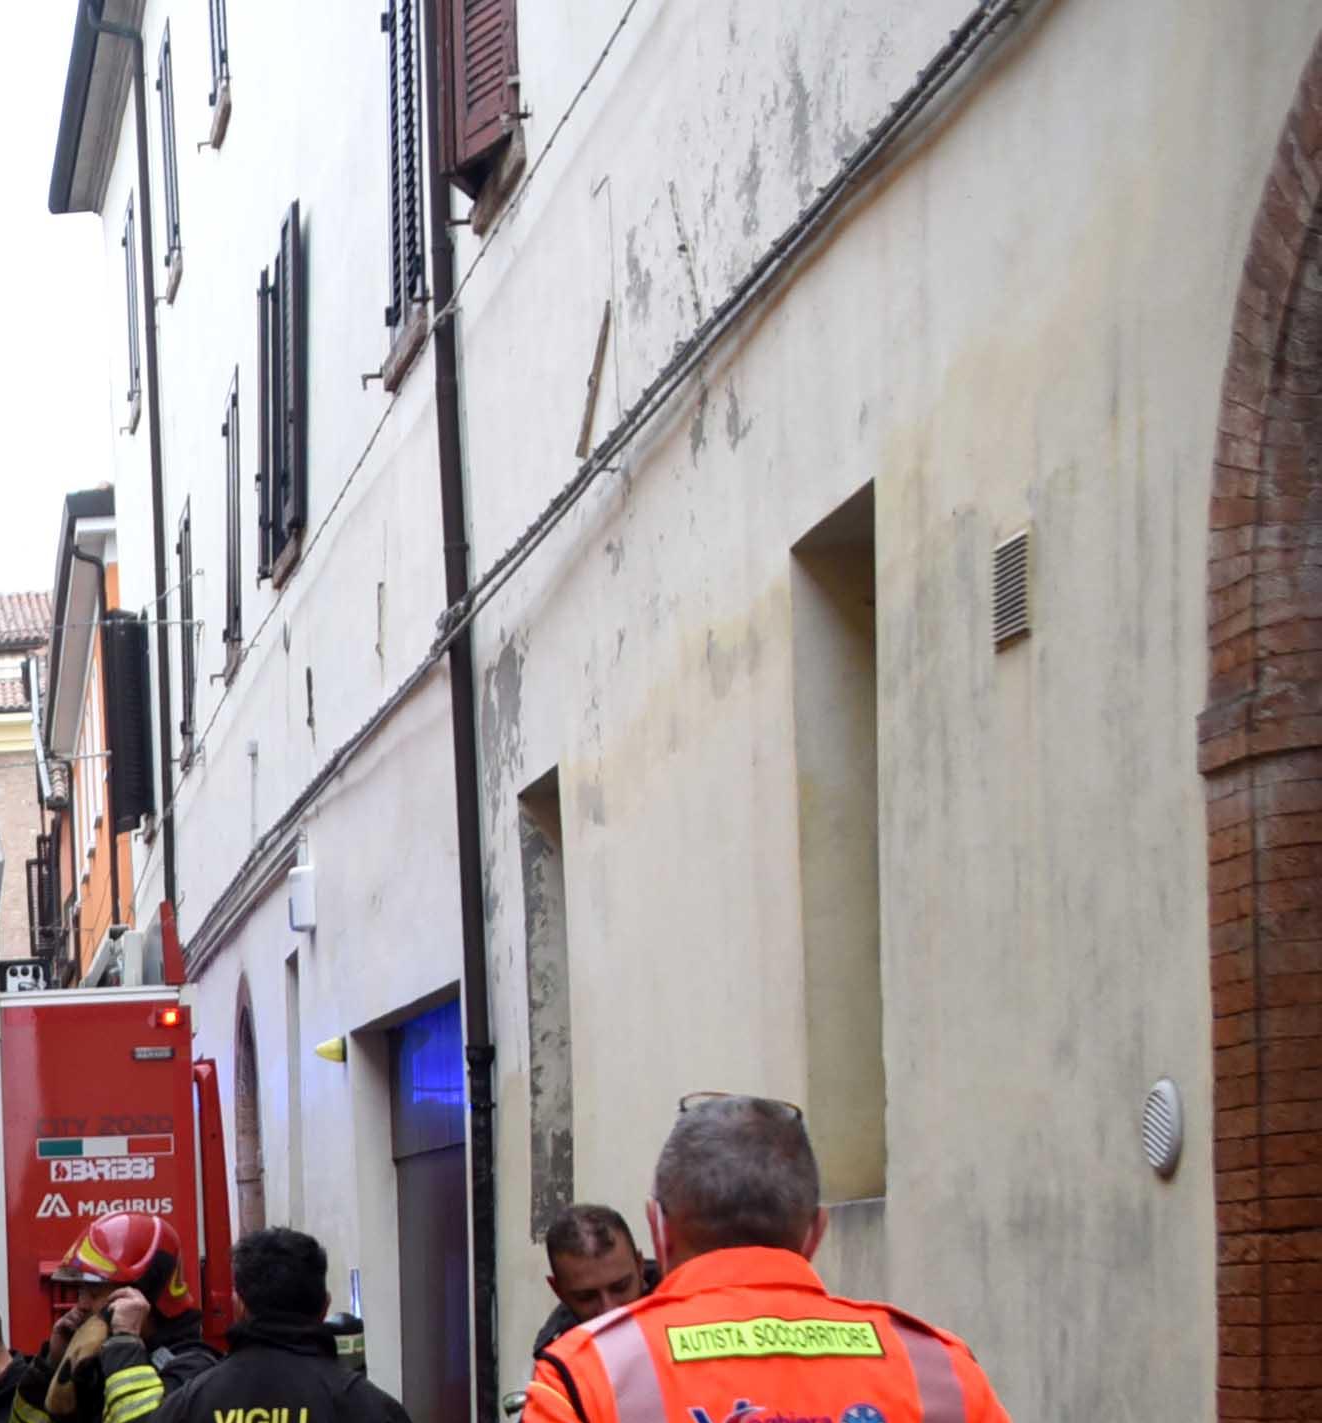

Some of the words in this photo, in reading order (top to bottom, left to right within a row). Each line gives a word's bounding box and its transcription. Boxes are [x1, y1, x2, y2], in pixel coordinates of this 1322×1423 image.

[77, 1197, 174, 1217] MAGIRUS
[679, 1327, 749, 1353] AUTISTA
[753, 1323, 874, 1348] SOCCORRITORE
